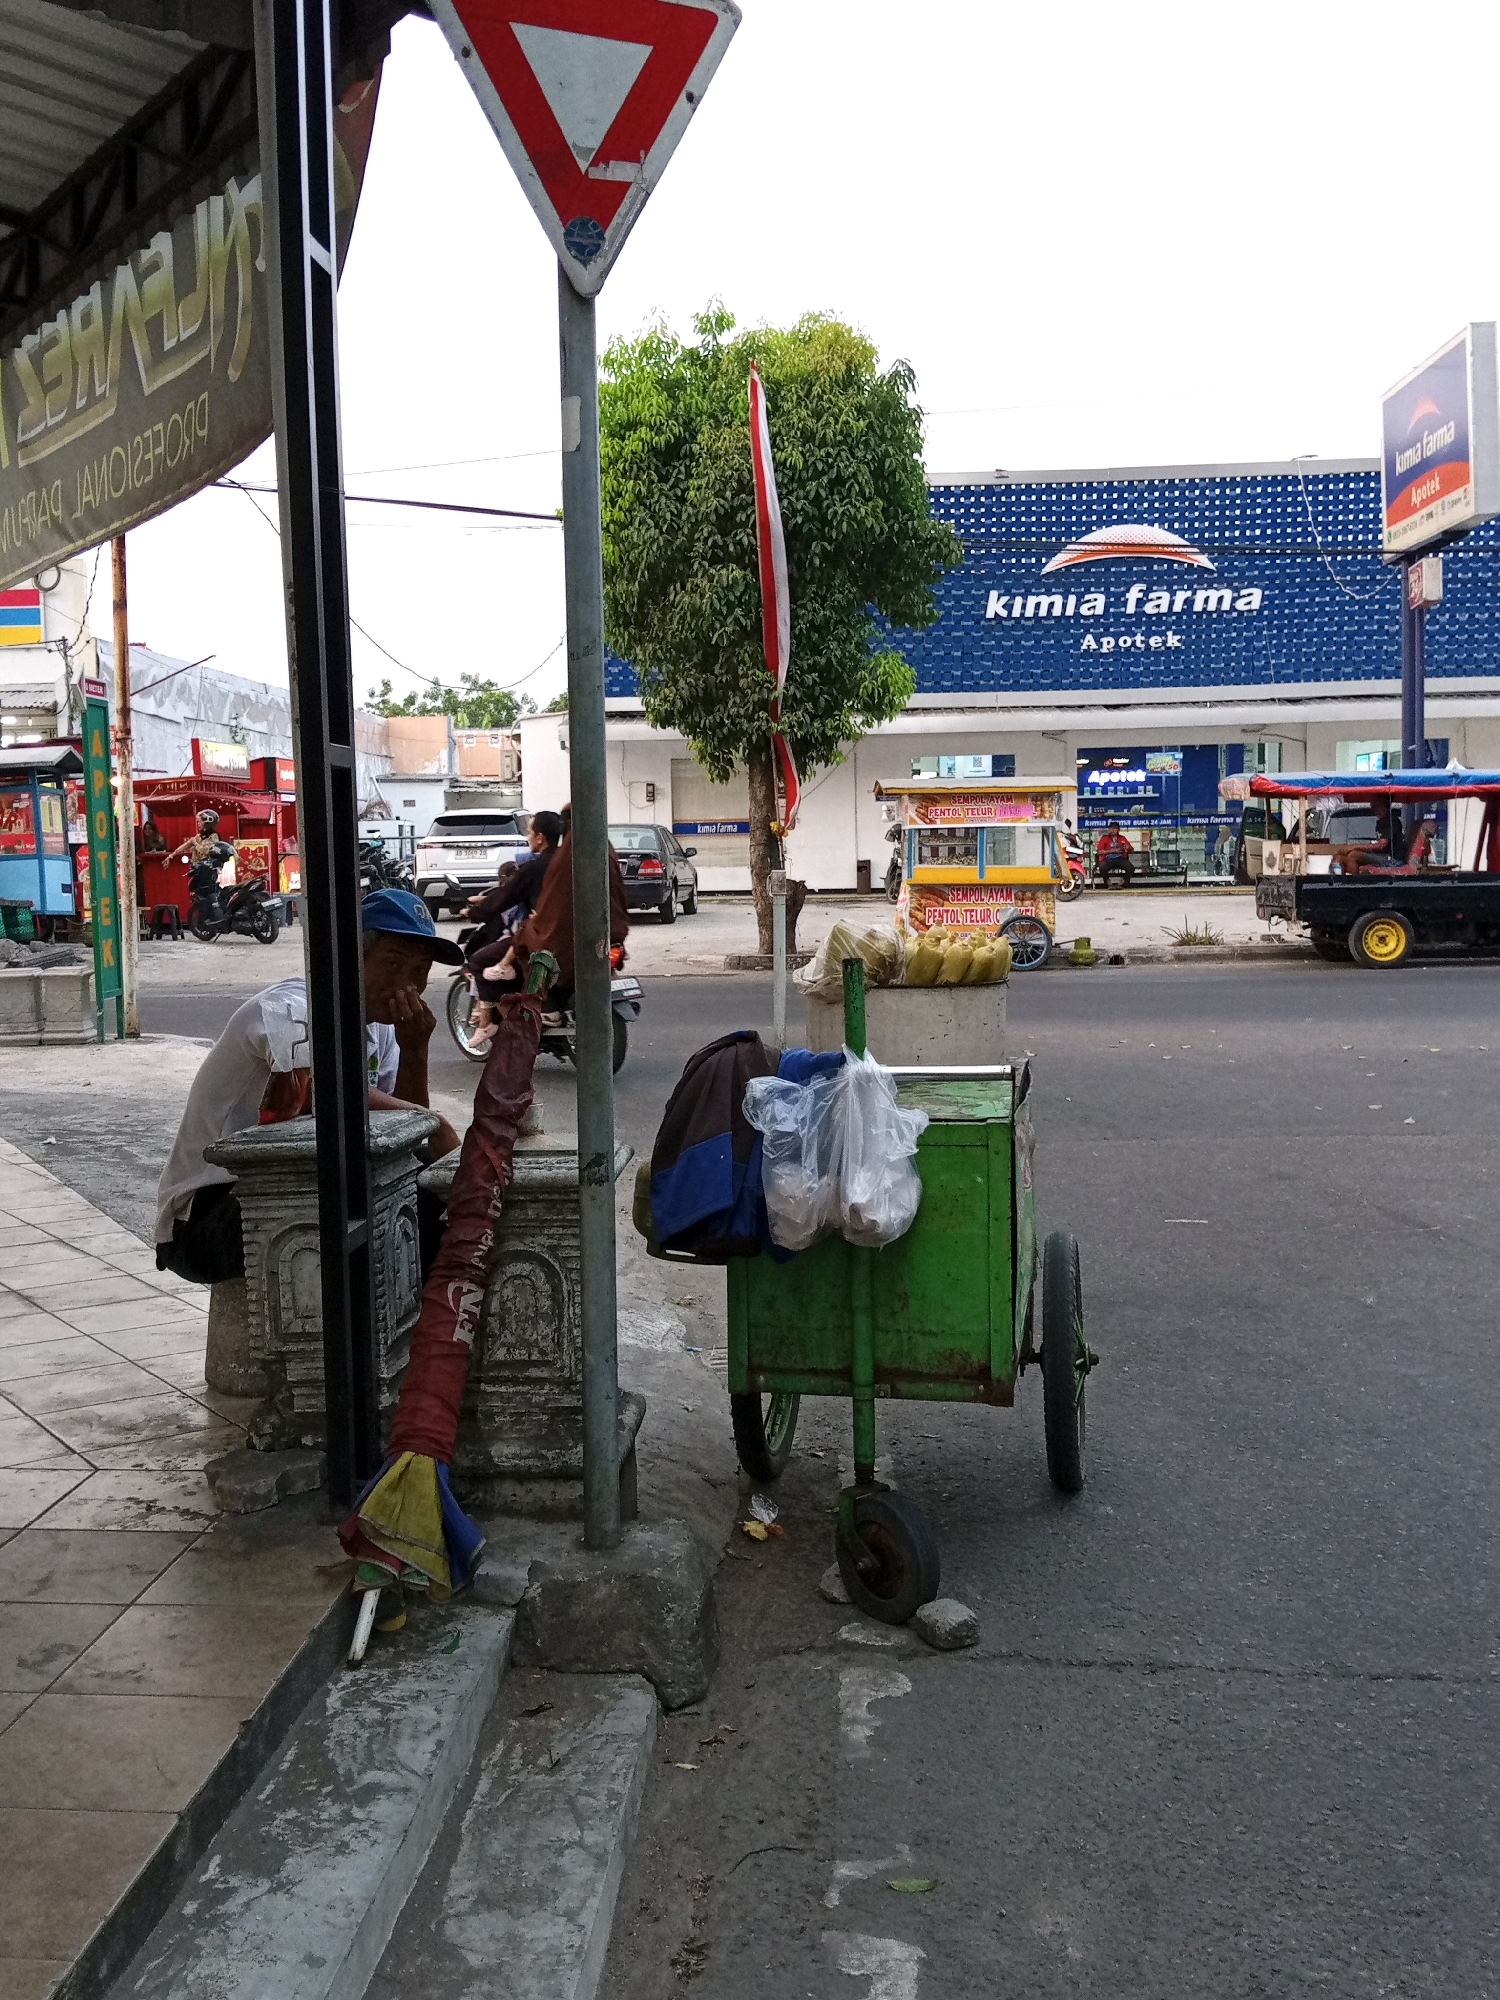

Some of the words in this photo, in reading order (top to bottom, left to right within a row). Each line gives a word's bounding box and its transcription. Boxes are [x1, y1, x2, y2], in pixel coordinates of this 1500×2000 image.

[1395, 441, 1421, 477] kimia
[1422, 420, 1455, 459] farma
[1410, 472, 1441, 509] Apotek
[985, 589, 1107, 619] kimia
[1124, 583, 1263, 615] farma
[1080, 630, 1182, 653] Apotek
[1087, 769, 1147, 786] Apotek
[950, 794, 986, 806] SEMPOL
[988, 794, 1014, 805] AYAM
[928, 807, 963, 818] PENTOL
[965, 806, 993, 817] TELUR
[1187, 816, 1209, 824] kimia
[1210, 815, 1234, 824] farma
[697, 823, 716, 833] kimia
[717, 822, 738, 833] farma
[91, 728, 116, 968] APOTEK
[950, 886, 985, 904] SEMPOL
[987, 886, 1014, 904] AYAM
[926, 907, 960, 926] PENTOL
[962, 907, 992, 925] TELUR
